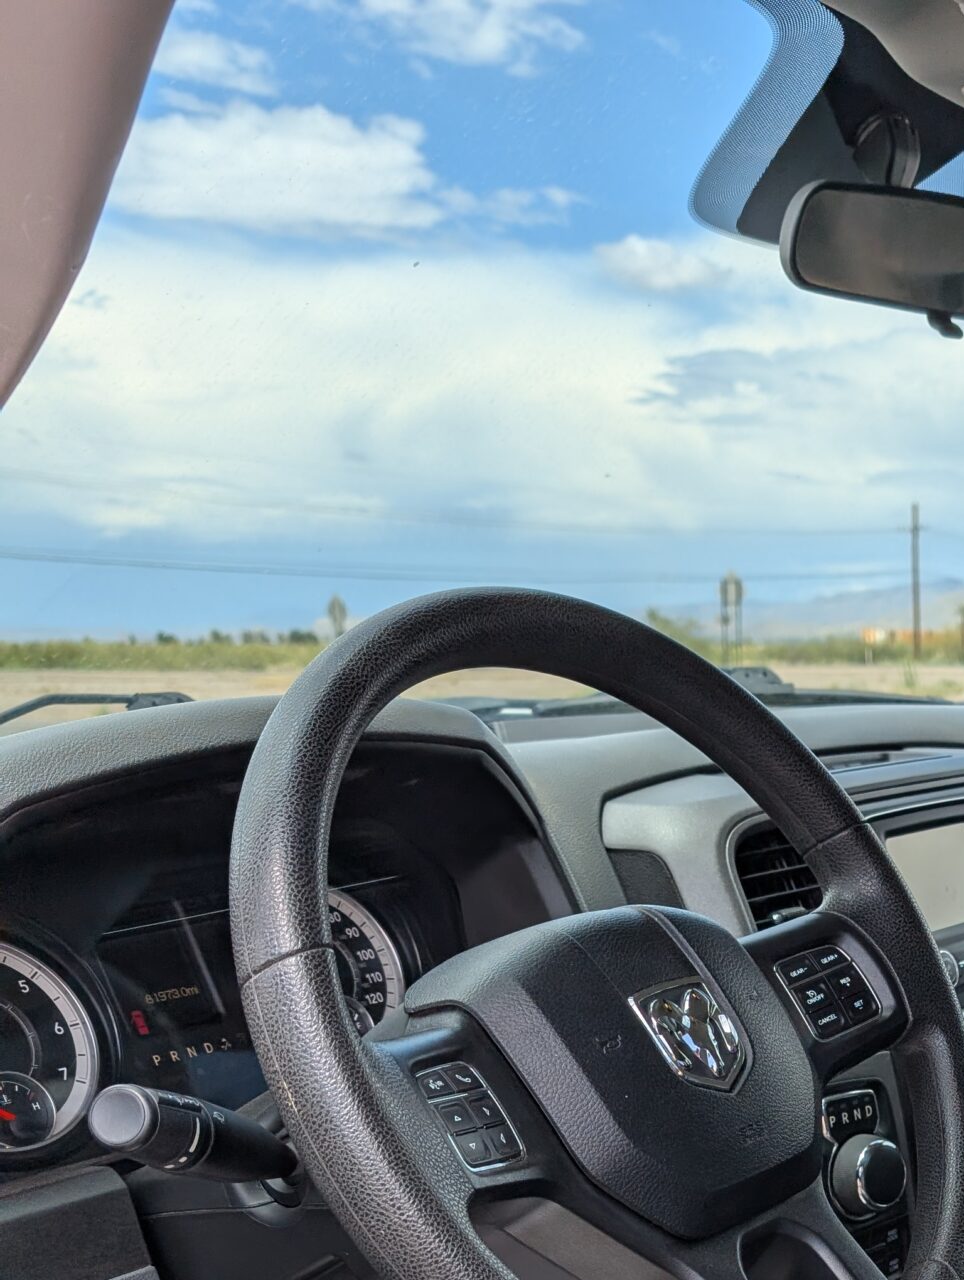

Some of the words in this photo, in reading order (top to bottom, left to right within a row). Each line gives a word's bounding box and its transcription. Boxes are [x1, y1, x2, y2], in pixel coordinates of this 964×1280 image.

[346, 926, 360, 938] 90
[356, 949, 375, 960] 100
[365, 972, 382, 984] 110
[18, 980, 30, 994] 5
[365, 992, 384, 1004] 120
[818, 1014, 838, 1026] CANCEL
[54, 1022, 64, 1035] 6
[152, 1054, 160, 1066] P
[170, 1050, 180, 1062] R
[186, 1046, 198, 1058] N
[204, 1042, 214, 1054] D
[58, 1067, 68, 1080] 7
[32, 1102, 40, 1110] H
[830, 1116, 836, 1128] P
[842, 1112, 849, 1124] R
[854, 1108, 862, 1120] N
[865, 1105, 872, 1118] D
